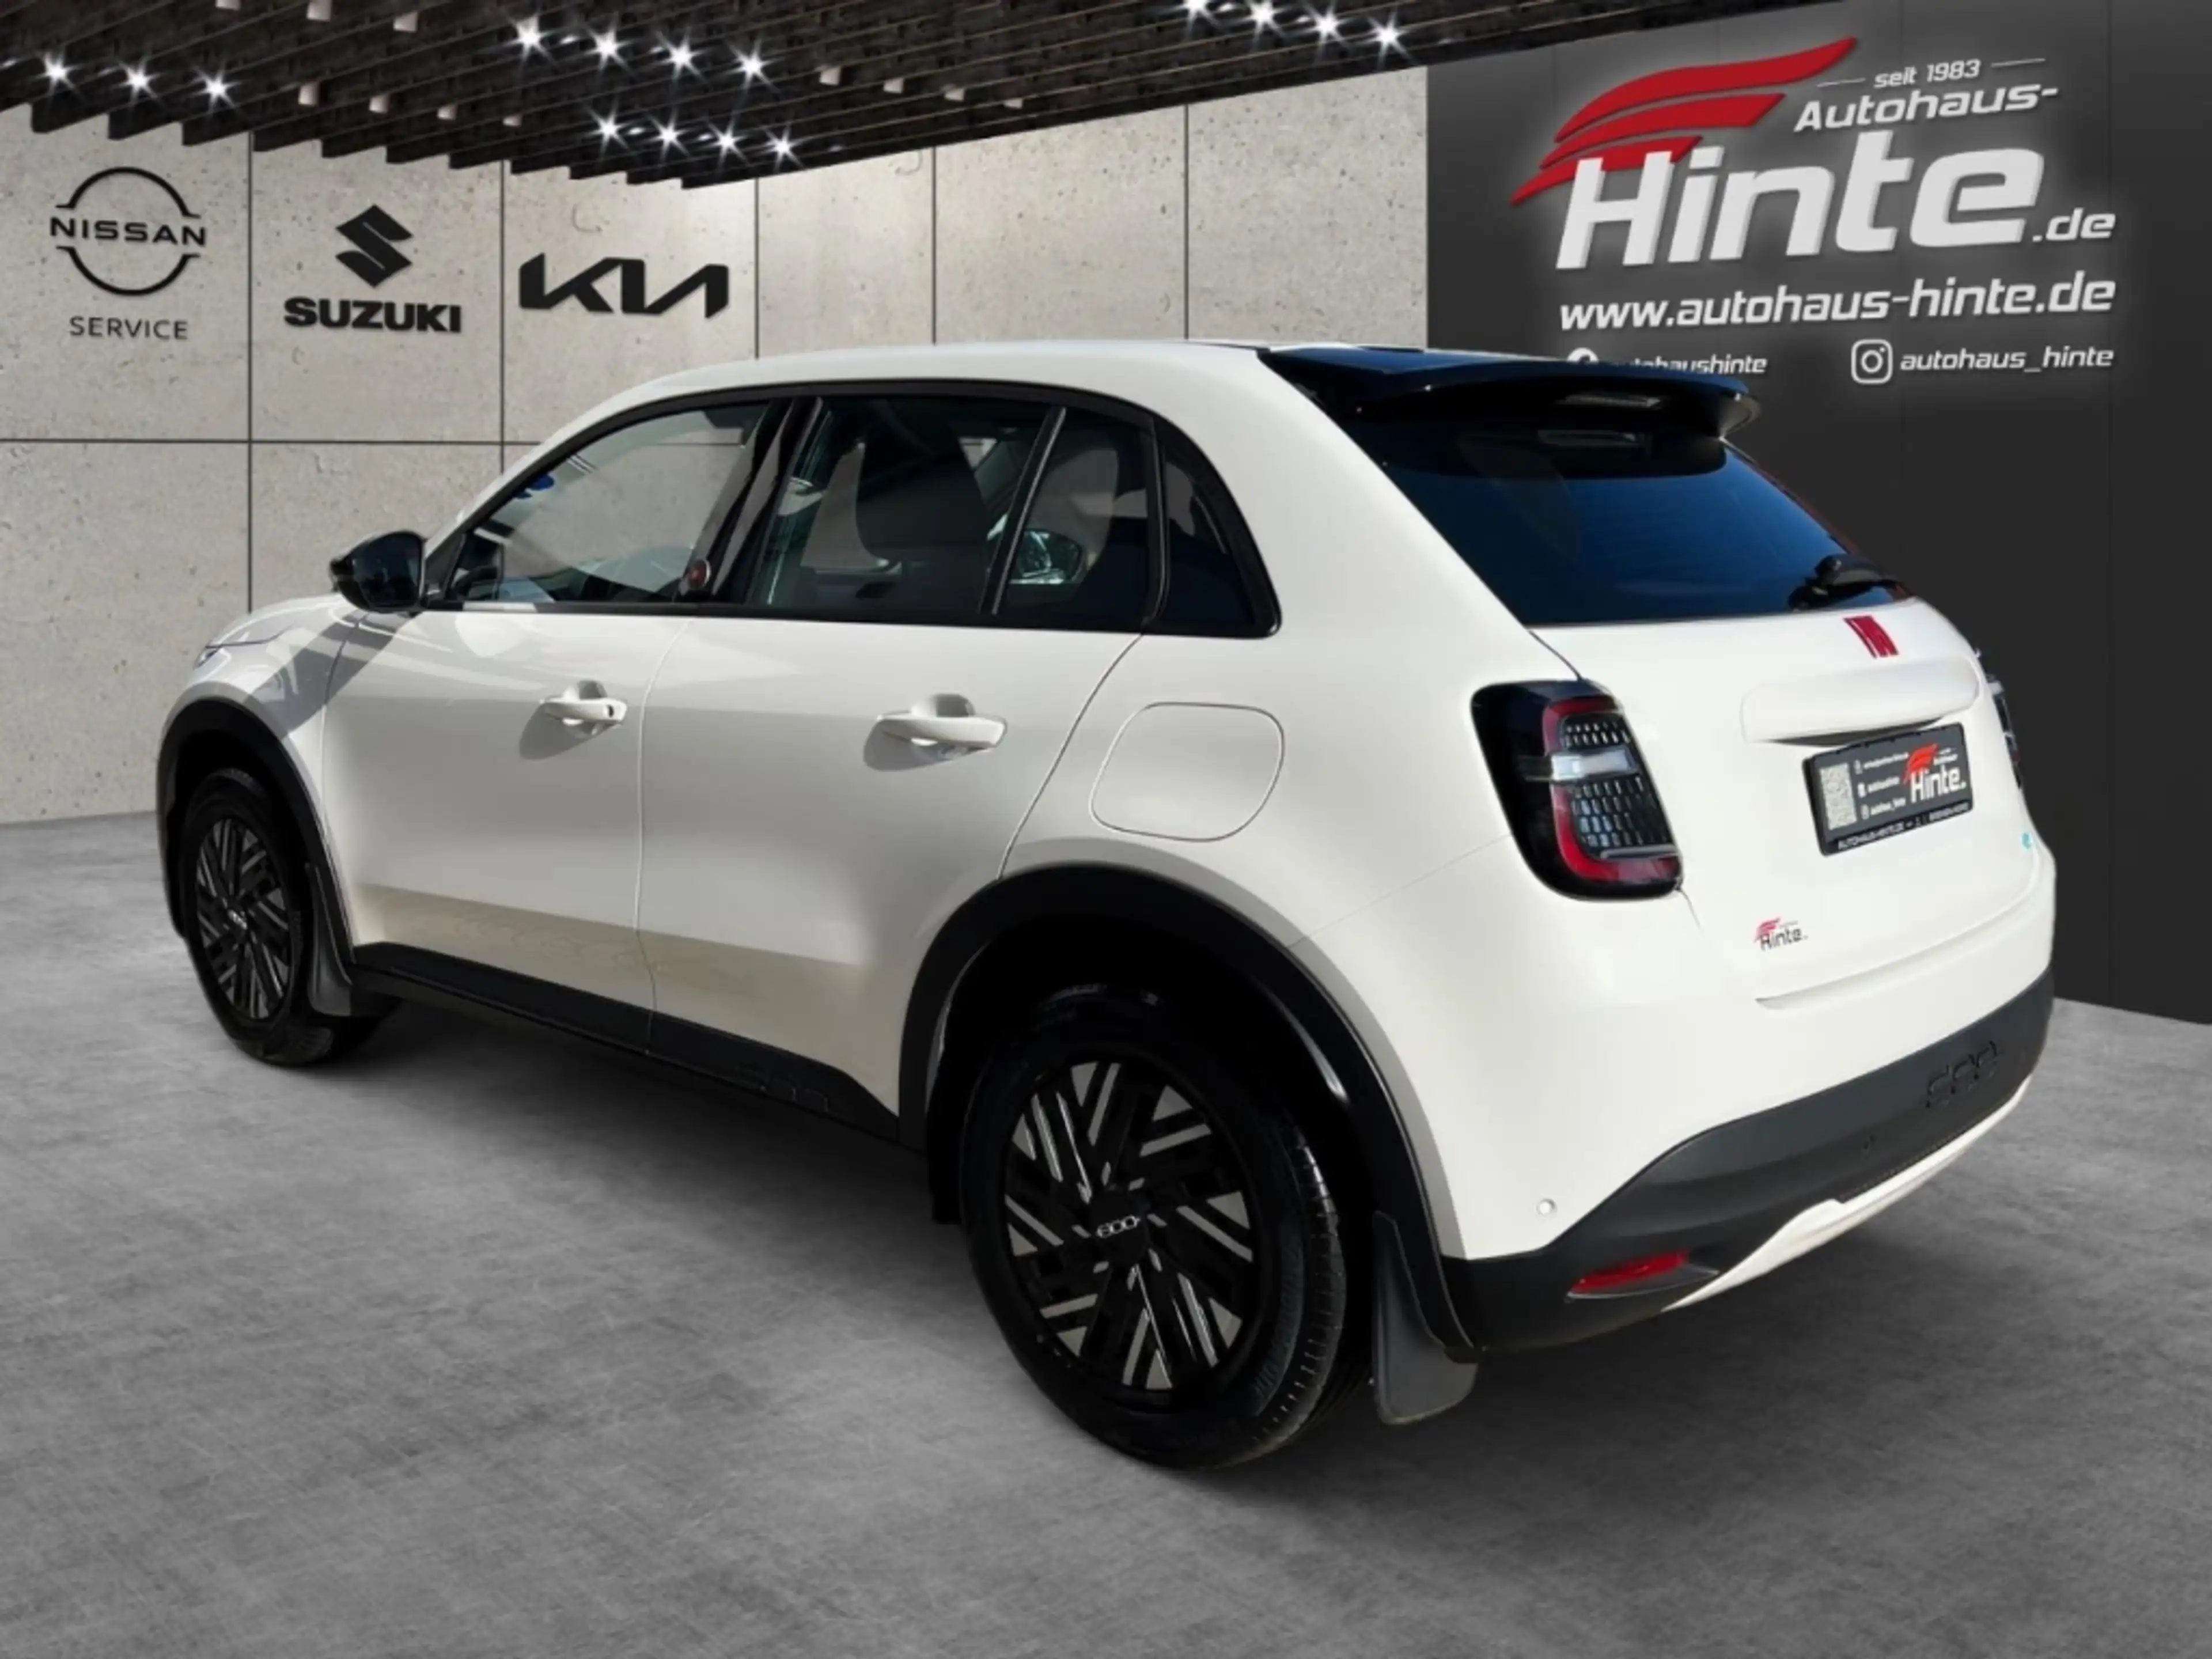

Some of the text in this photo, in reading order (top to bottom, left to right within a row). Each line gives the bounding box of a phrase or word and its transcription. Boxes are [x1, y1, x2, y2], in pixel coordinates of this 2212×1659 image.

[1873, 58, 1981, 89] seit 1983
[1793, 84, 2058, 132] Autohaus-
[50, 217, 206, 247] NISSAN
[519, 253, 729, 319] KIA
[1560, 270, 2116, 330] www.autohaus-hinte.de
[69, 316, 188, 340] SERVICE
[284, 297, 461, 333] SUZUKI
[1900, 346, 2113, 372] autohaus_hinte
